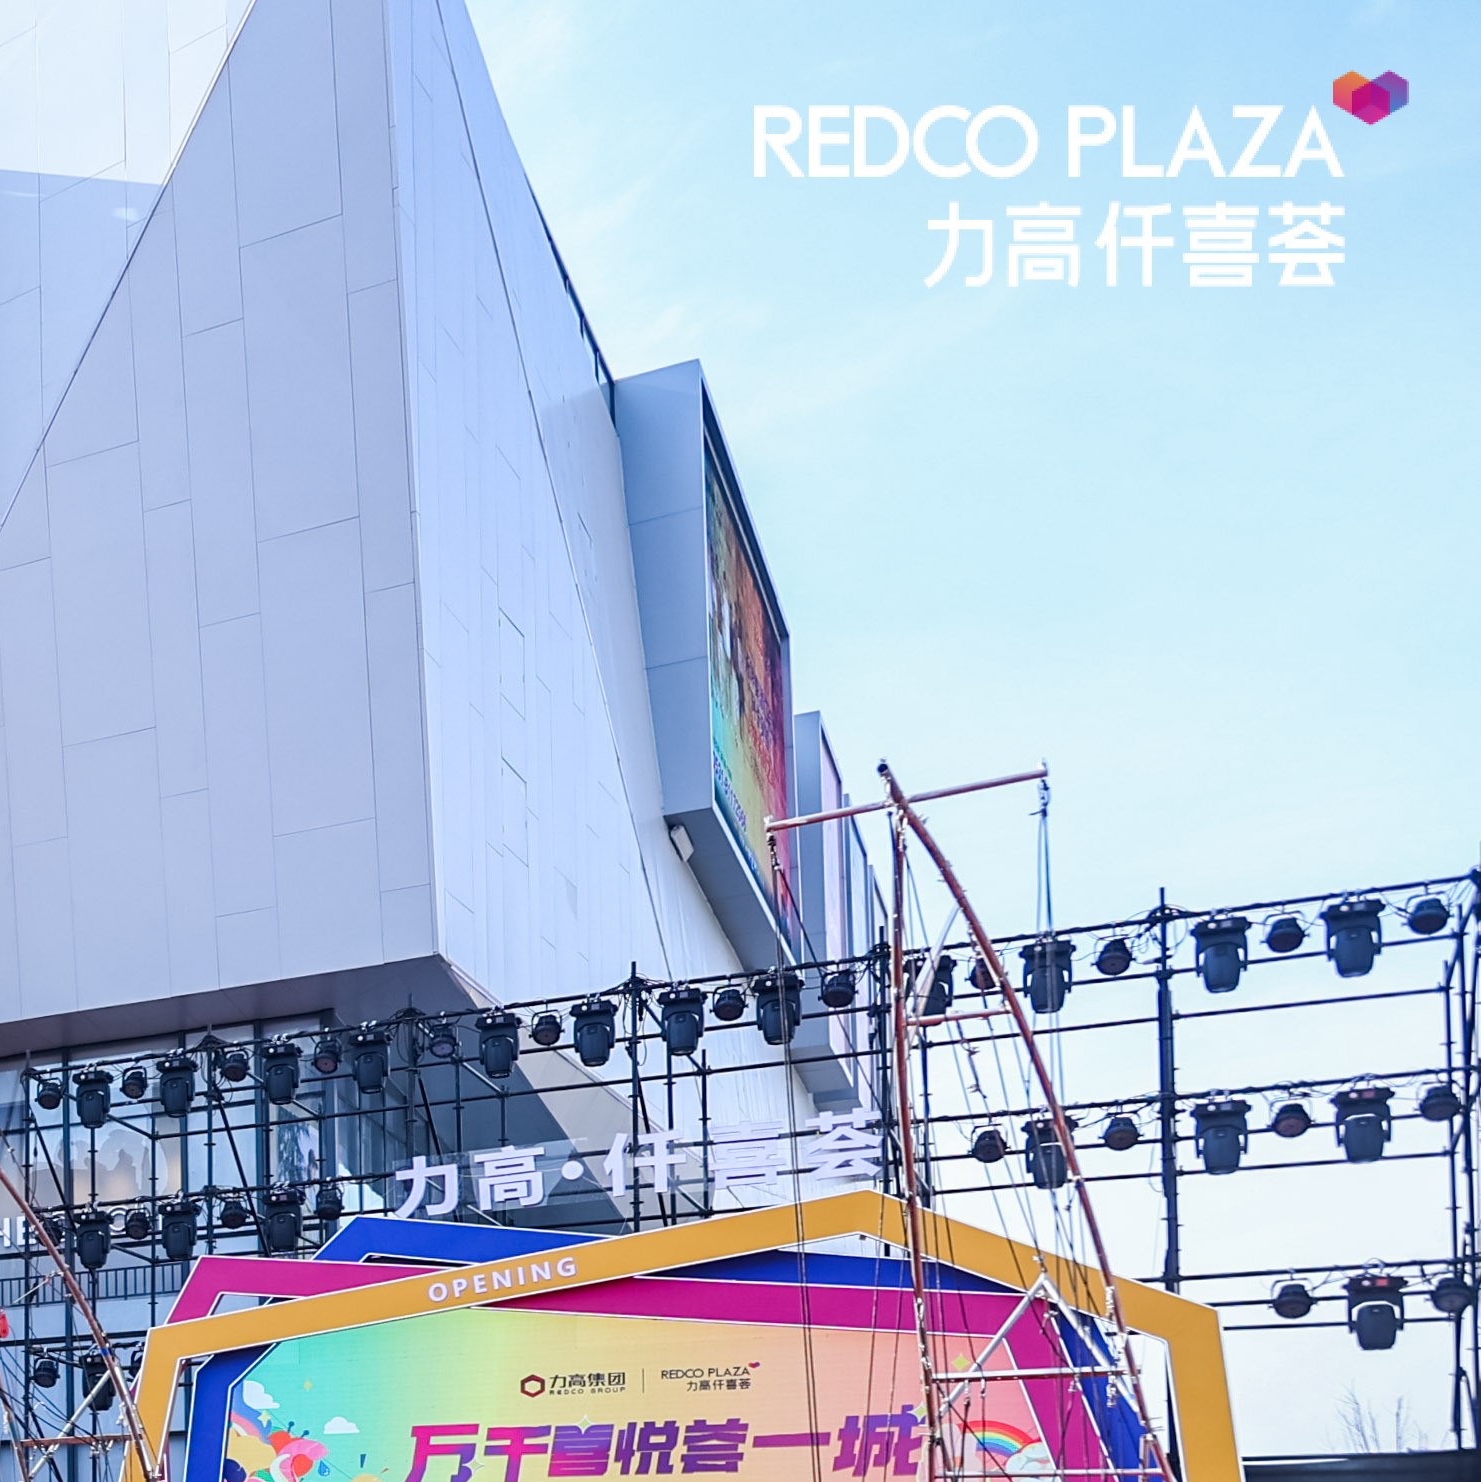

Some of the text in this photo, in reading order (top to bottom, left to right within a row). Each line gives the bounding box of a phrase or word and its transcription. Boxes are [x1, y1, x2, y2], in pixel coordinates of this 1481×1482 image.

[427, 1256, 578, 1303] OPENING
[549, 1372, 626, 1389] 力高集团
[661, 1366, 751, 1380] REDCO PLAZA
